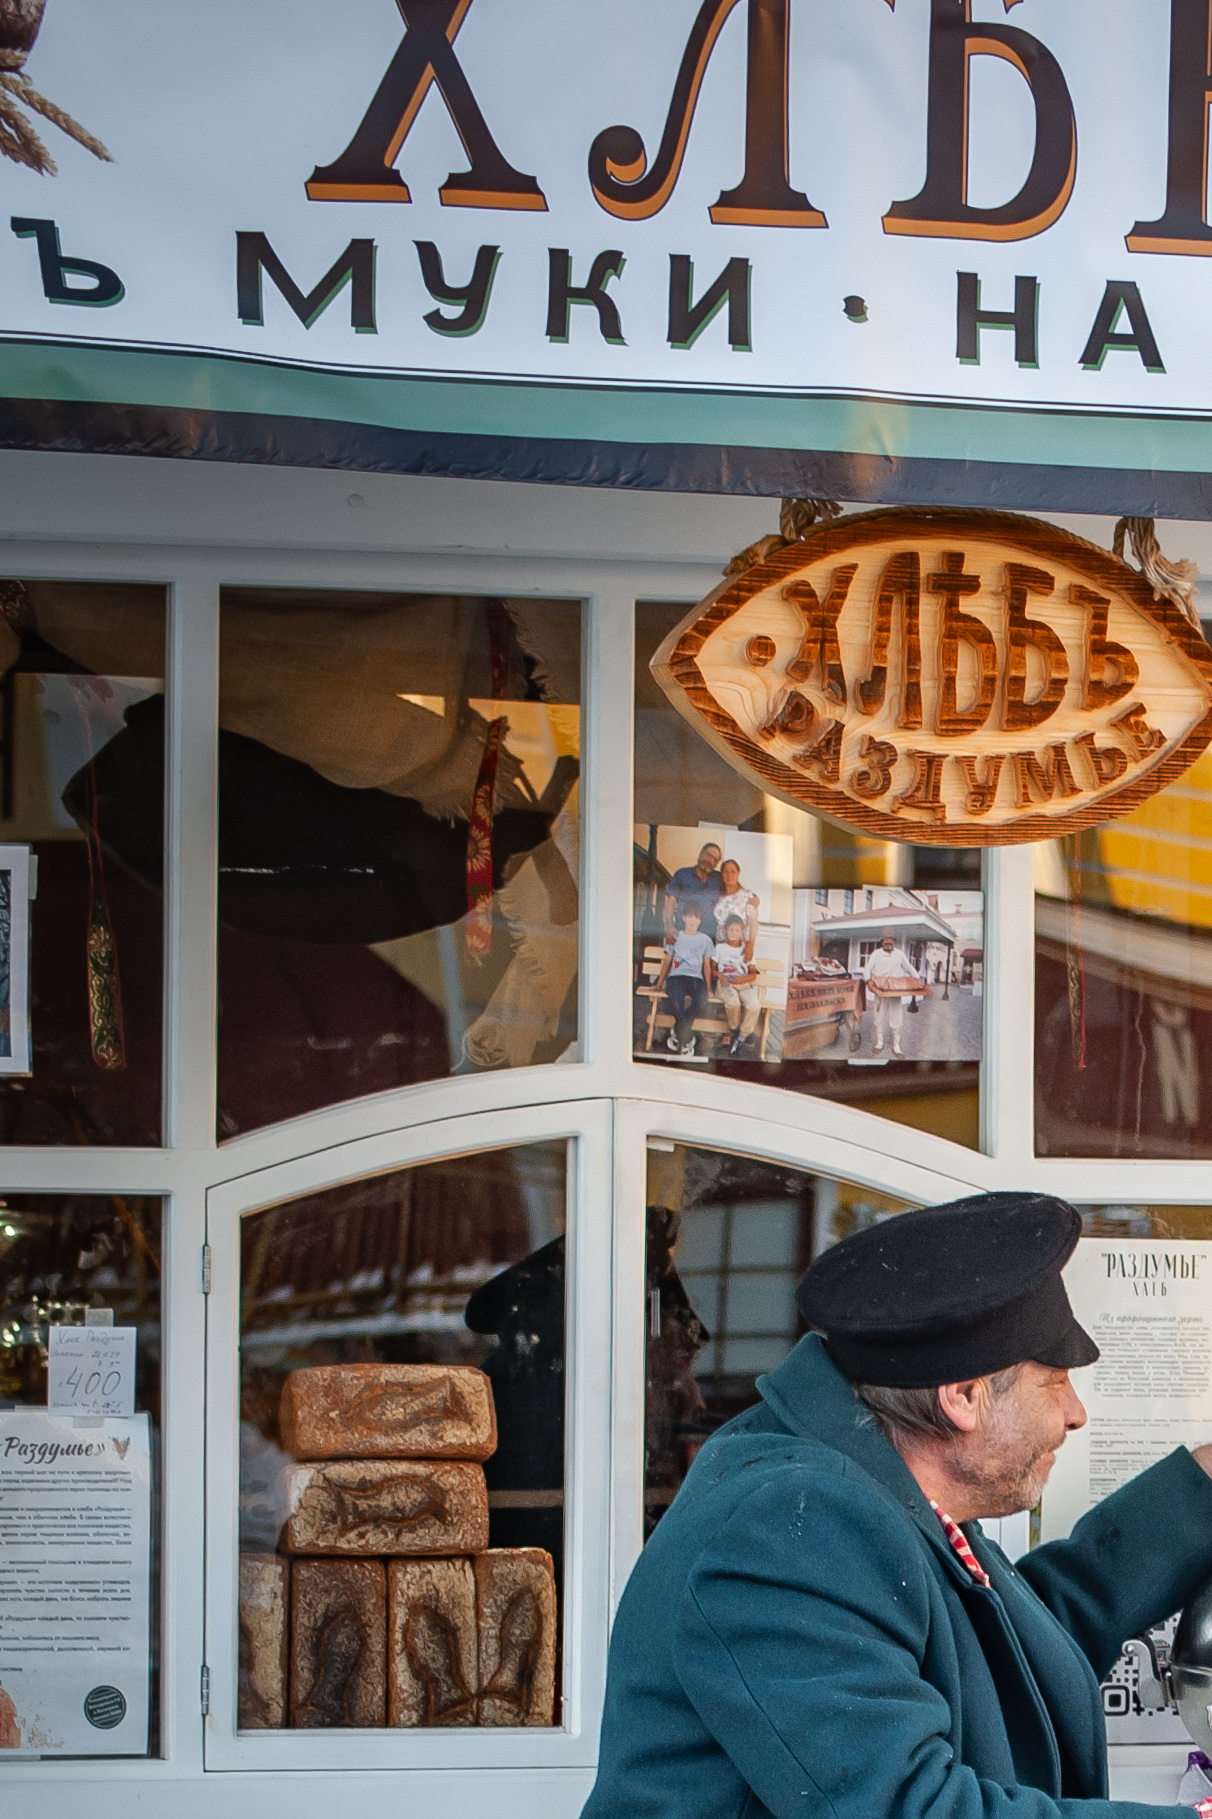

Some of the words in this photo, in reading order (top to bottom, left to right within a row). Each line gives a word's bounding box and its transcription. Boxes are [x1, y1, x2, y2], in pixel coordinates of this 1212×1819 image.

[235, 230, 753, 354] МУКИ
[956, 270, 1167, 376] НА
[781, 551, 1140, 736] ХЛѢБЪ
[65, 1364, 122, 1398] 400
